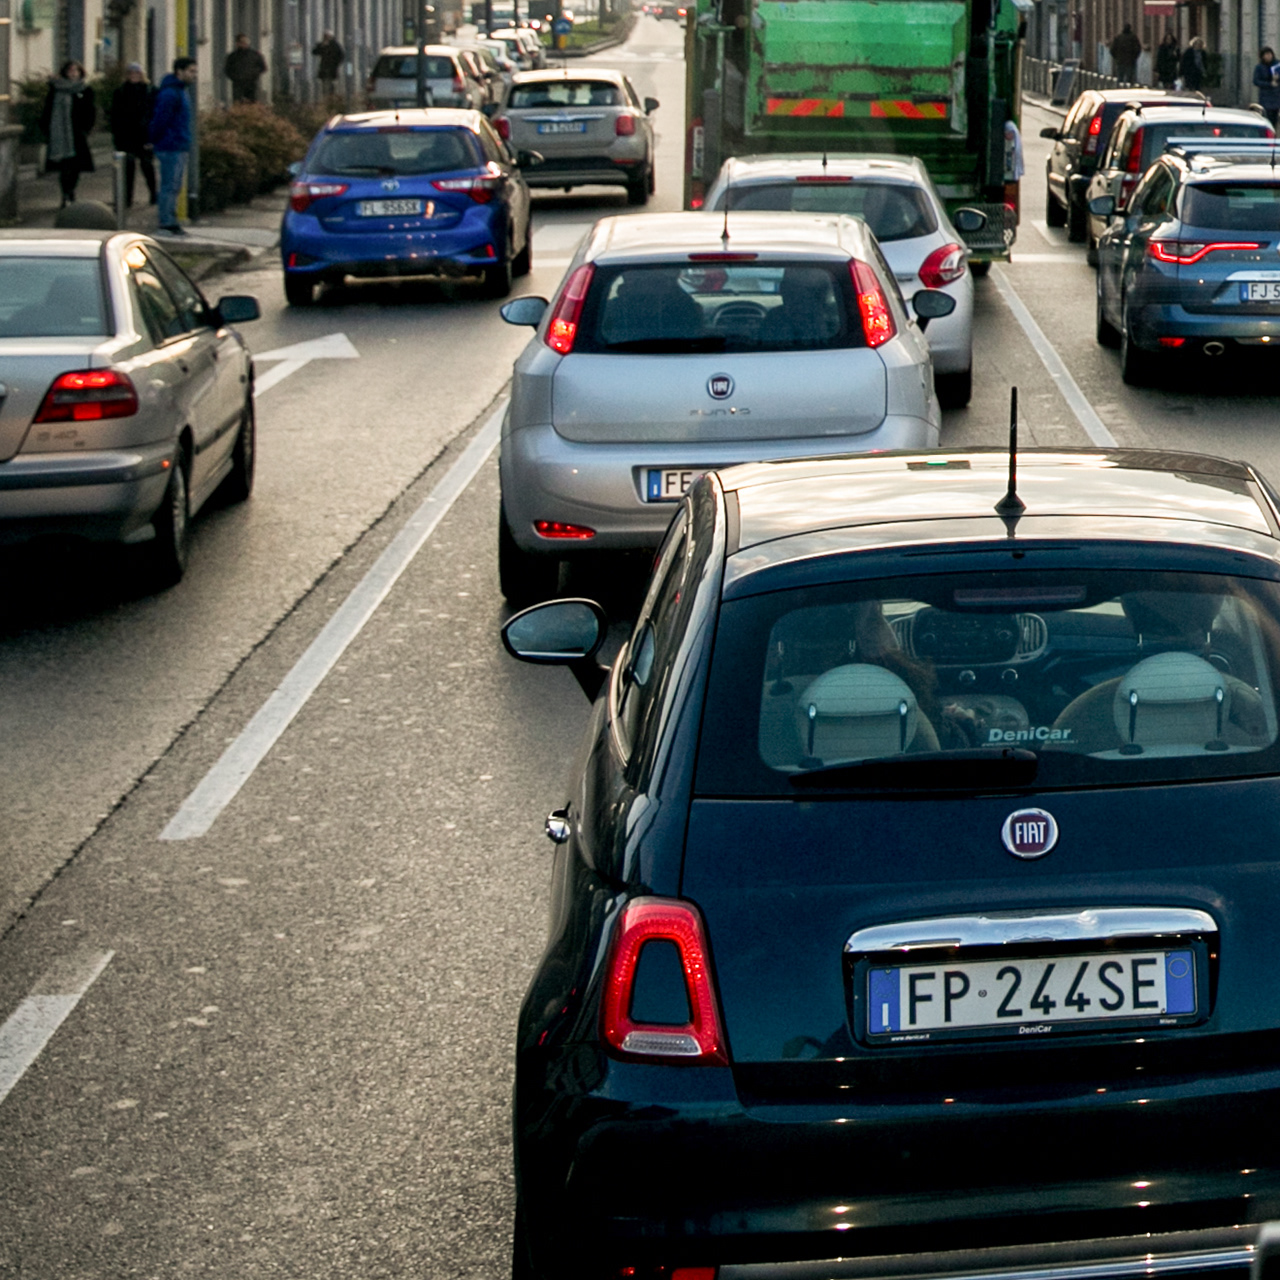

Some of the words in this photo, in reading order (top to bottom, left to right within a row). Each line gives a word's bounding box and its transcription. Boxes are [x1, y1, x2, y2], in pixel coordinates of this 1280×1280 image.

[1251, 284, 1267, 298] FJ
[714, 381, 728, 392] FIAT
[989, 726, 1071, 741] DeniCar
[1015, 822, 1046, 844] FIAT
[909, 971, 970, 1025] FP
[996, 957, 1159, 1018] 244SE
[1019, 1024, 1052, 1035] DeniCar
[890, 1033, 930, 1041] www.denicar.it
